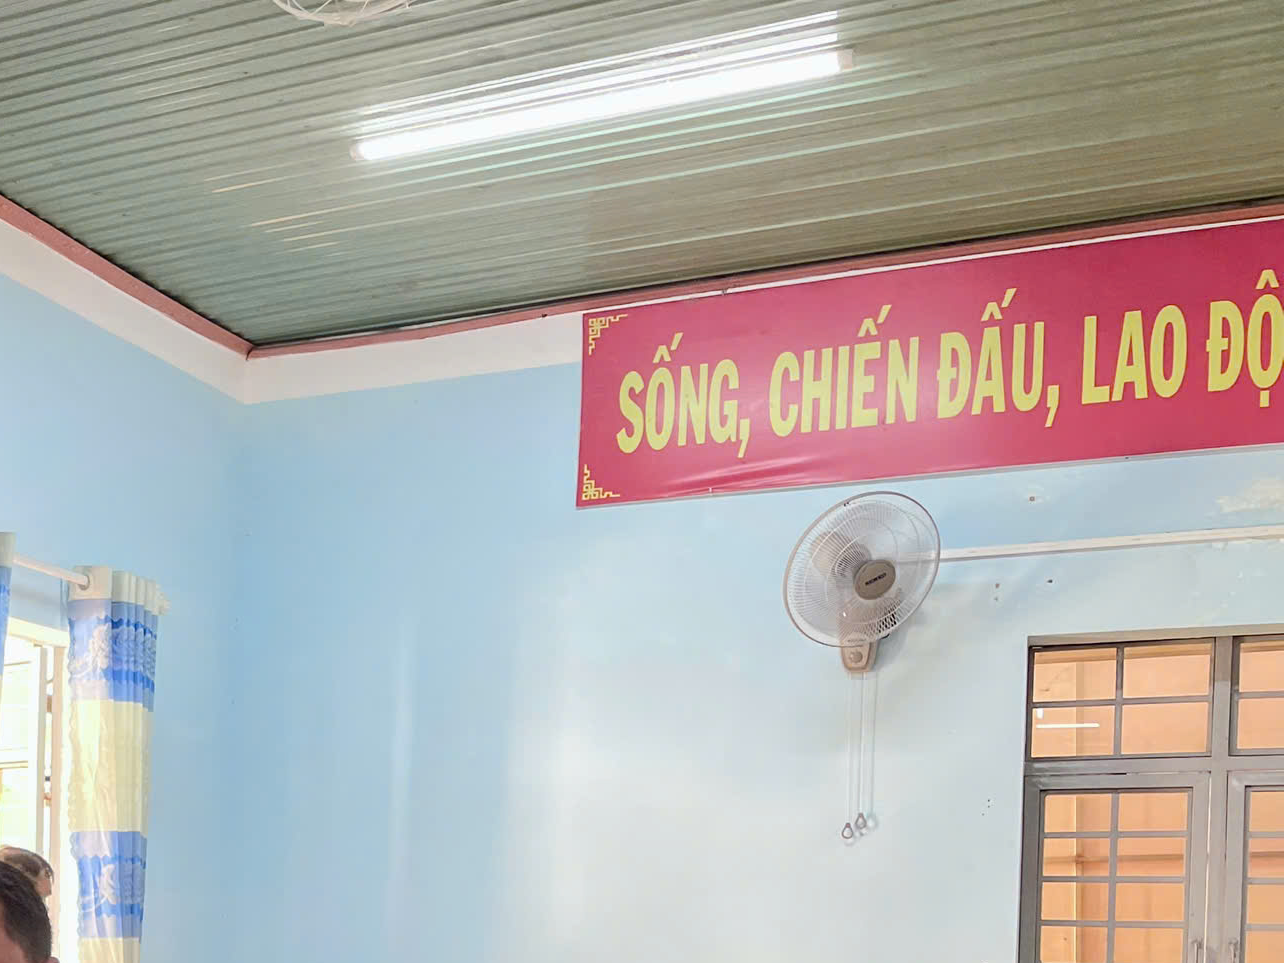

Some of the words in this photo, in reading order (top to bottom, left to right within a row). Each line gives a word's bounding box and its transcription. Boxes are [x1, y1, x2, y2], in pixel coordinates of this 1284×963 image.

[616, 332, 750, 458] SỐNG,
[769, 304, 920, 437] CHIẾN
[936, 288, 1060, 428] ĐẤU,
[1081, 304, 1188, 405] LAO
[1205, 269, 1284, 408] ĐỘ
